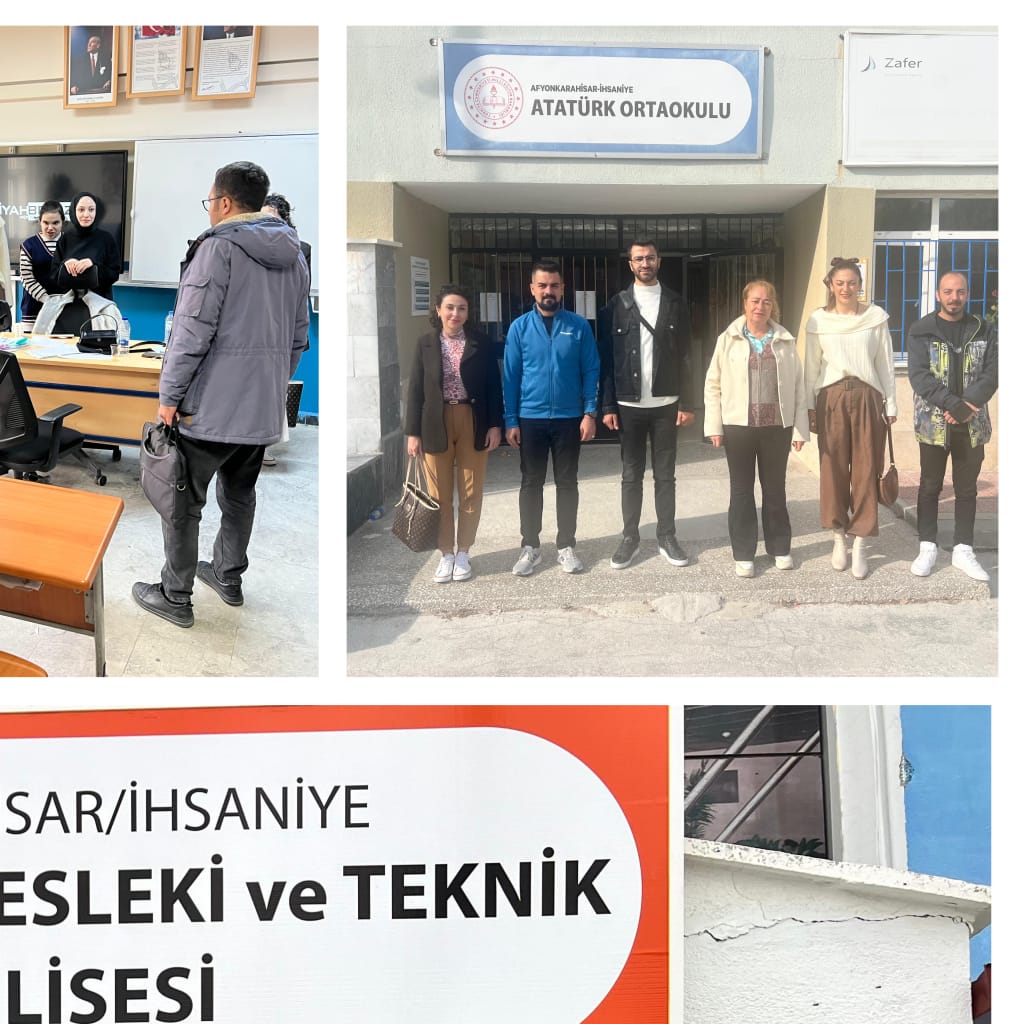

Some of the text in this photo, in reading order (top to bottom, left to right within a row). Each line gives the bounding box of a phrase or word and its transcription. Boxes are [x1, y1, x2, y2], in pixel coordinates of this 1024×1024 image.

[884, 57, 923, 69] Zafer
[530, 83, 634, 94] AFYONKARAHİSAR-İHSANİYE
[531, 96, 615, 117] ATATÜRK
[619, 100, 731, 119] ORTAOKULU
[246, 879, 327, 922] ve
[343, 846, 612, 921] TEKNİK
